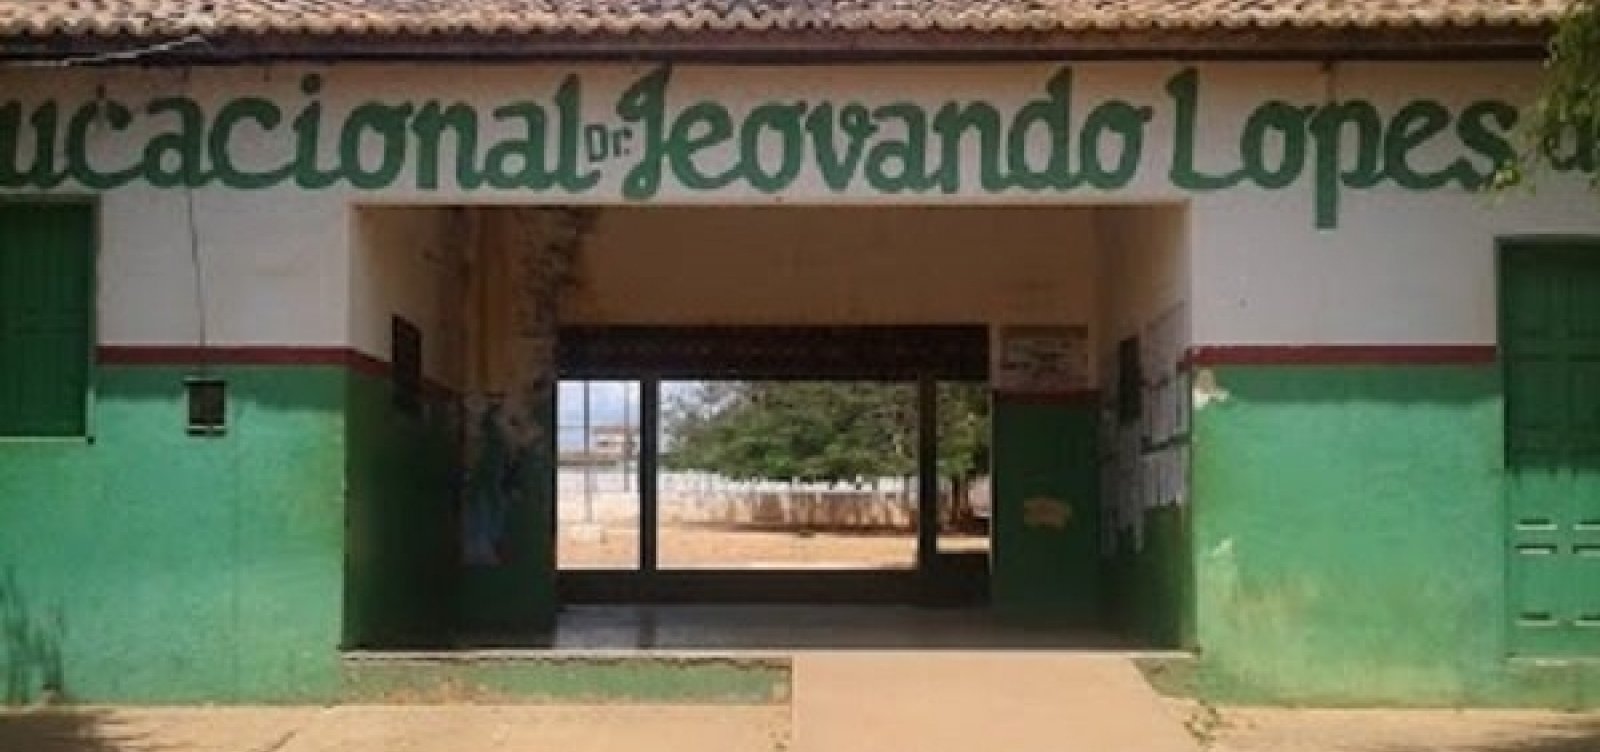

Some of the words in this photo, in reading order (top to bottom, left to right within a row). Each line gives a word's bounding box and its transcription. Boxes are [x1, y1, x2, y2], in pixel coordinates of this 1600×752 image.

[584, 123, 632, 162] Dr.
[615, 63, 1153, 200] Jeovando
[1165, 66, 1518, 229] Lopes
